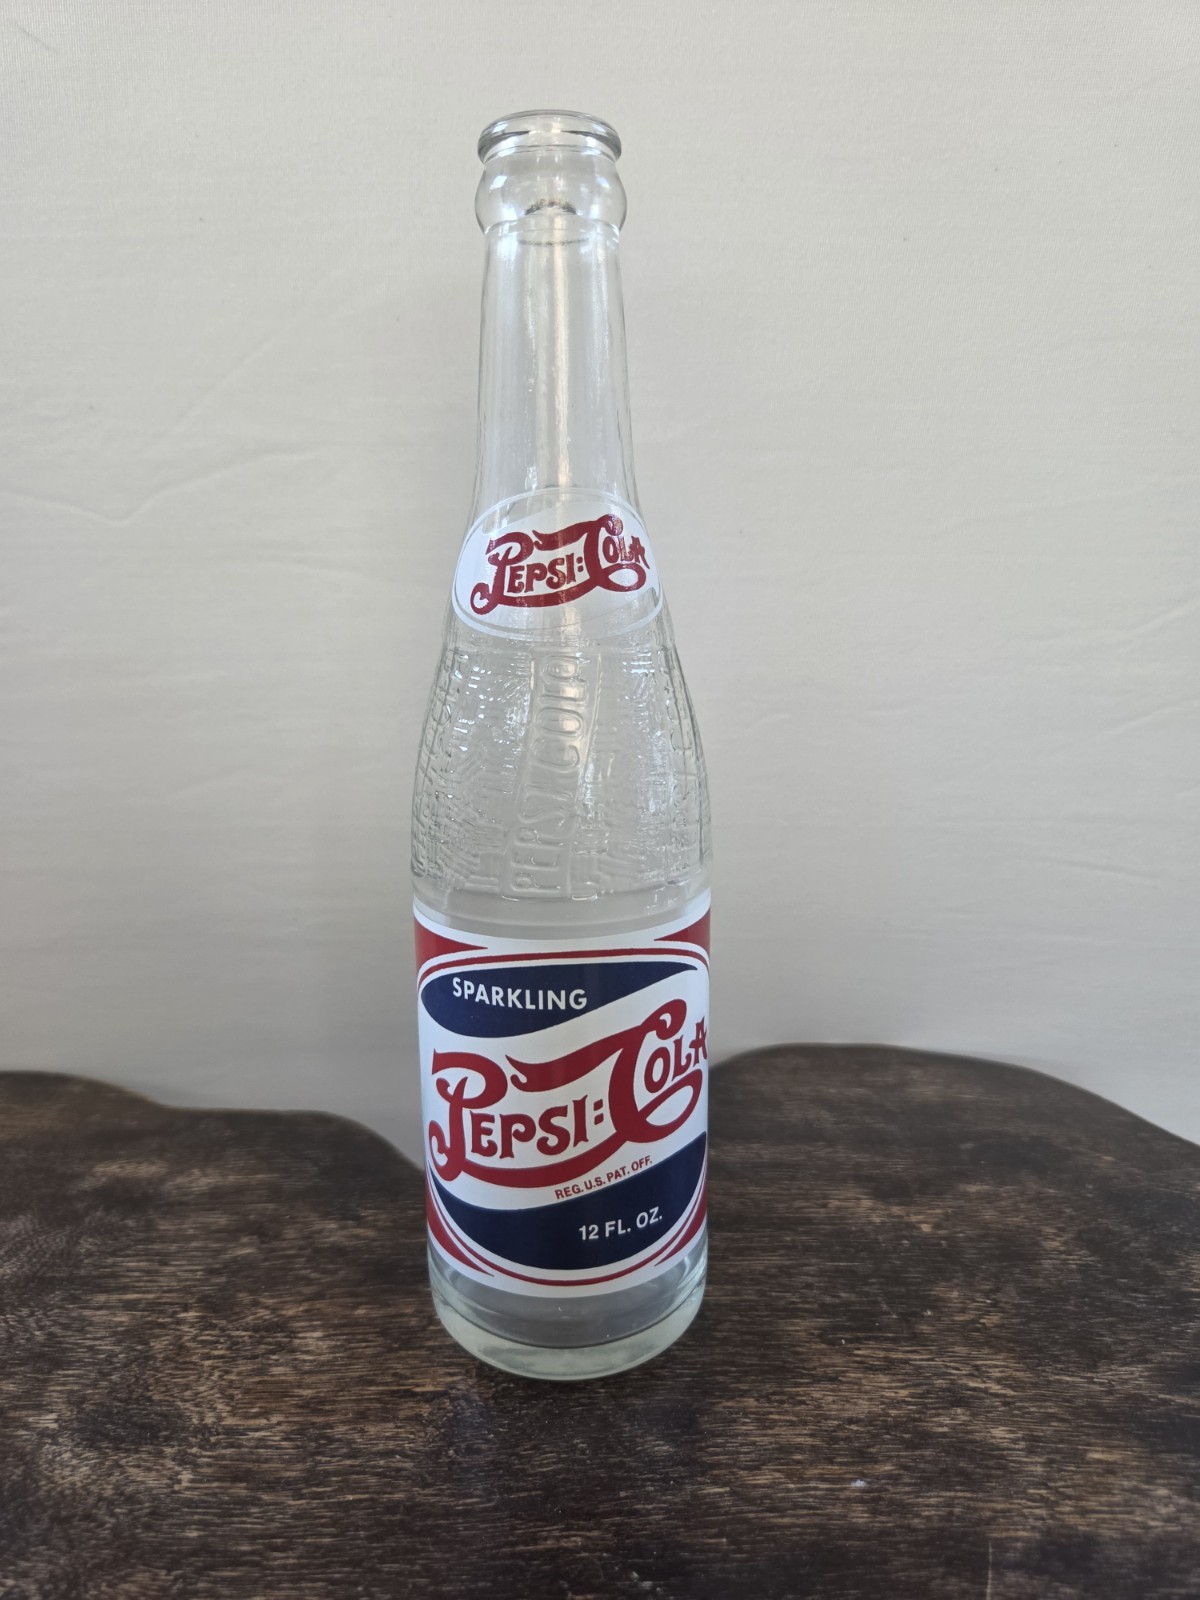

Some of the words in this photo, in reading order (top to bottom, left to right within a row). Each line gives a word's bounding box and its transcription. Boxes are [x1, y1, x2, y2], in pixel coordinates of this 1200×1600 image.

[452, 977, 588, 1010] SPARKLING
[554, 1183, 584, 1200] REG.
[584, 1176, 606, 1191] U.S.
[606, 1165, 630, 1183] PAT.
[631, 1155, 653, 1172] OFF.
[579, 1224, 599, 1241] 12
[605, 1219, 632, 1238] FL.
[636, 1206, 663, 1229] OZ.
